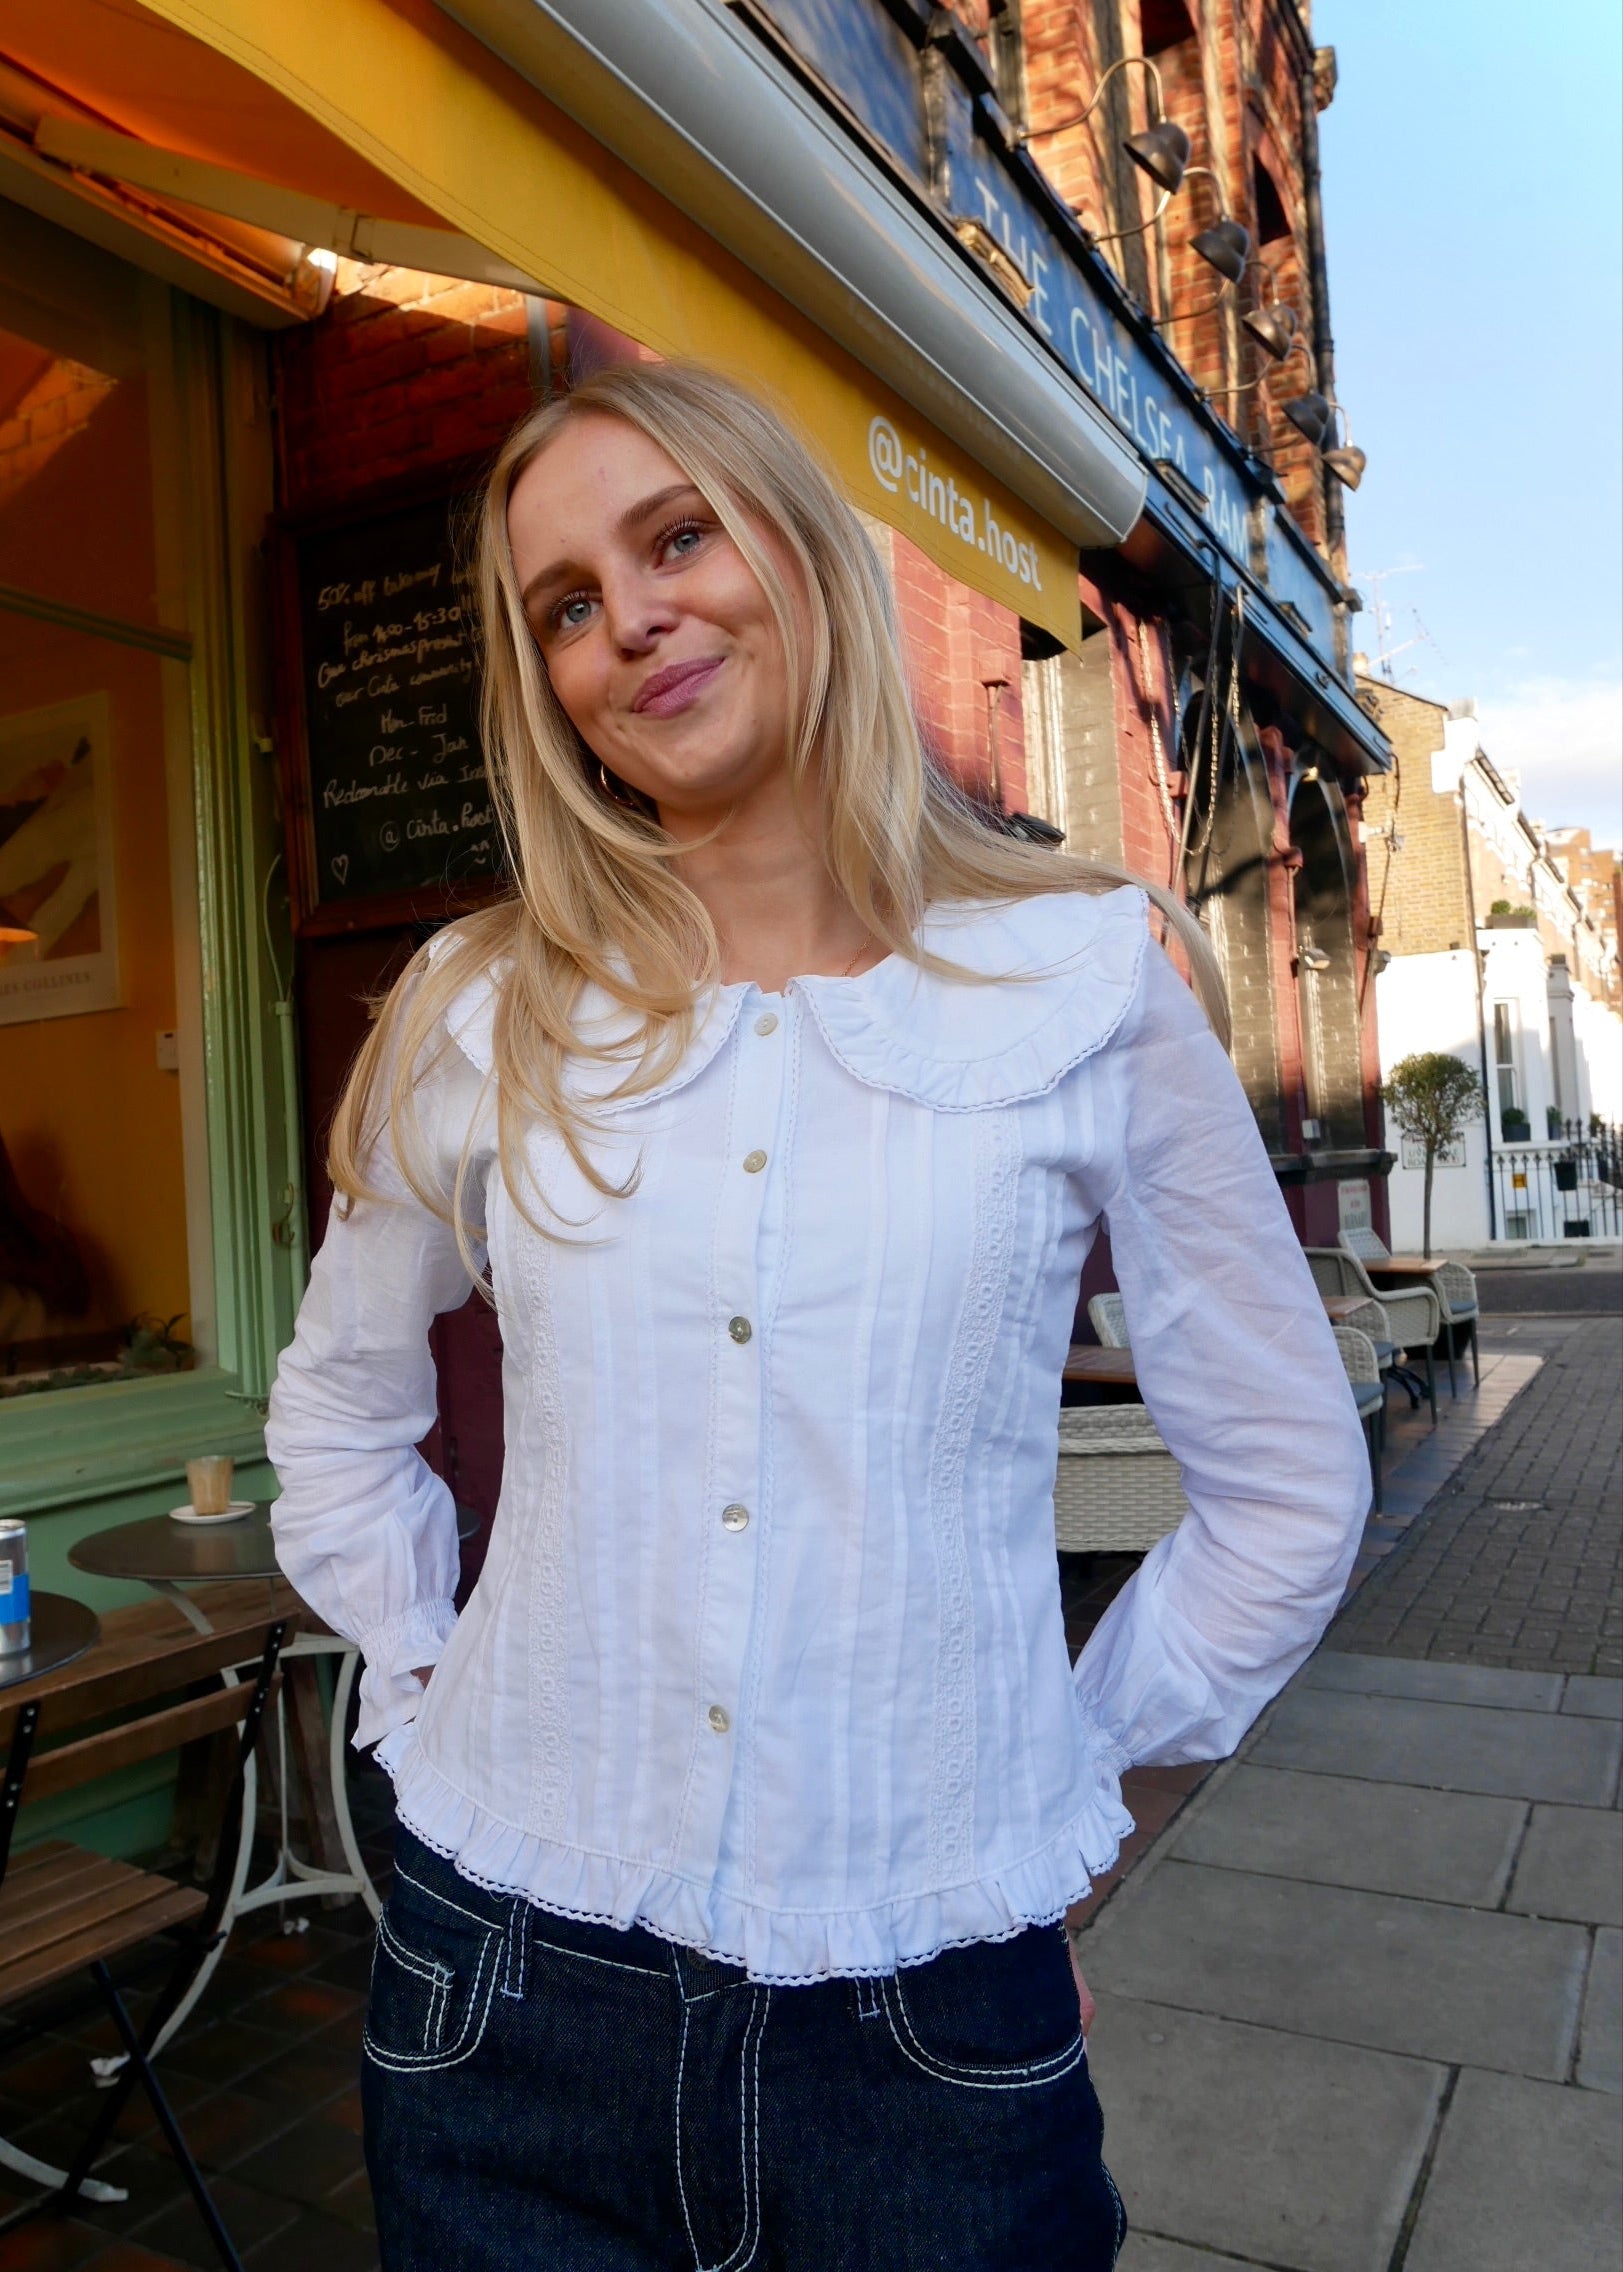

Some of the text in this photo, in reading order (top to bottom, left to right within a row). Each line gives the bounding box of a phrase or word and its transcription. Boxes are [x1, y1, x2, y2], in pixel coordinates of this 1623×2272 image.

[975, 176, 1053, 337] THE
[1203, 465, 1250, 570] RAM
[868, 415, 1043, 592] @cinta.host
[416, 771, 449, 791] via
